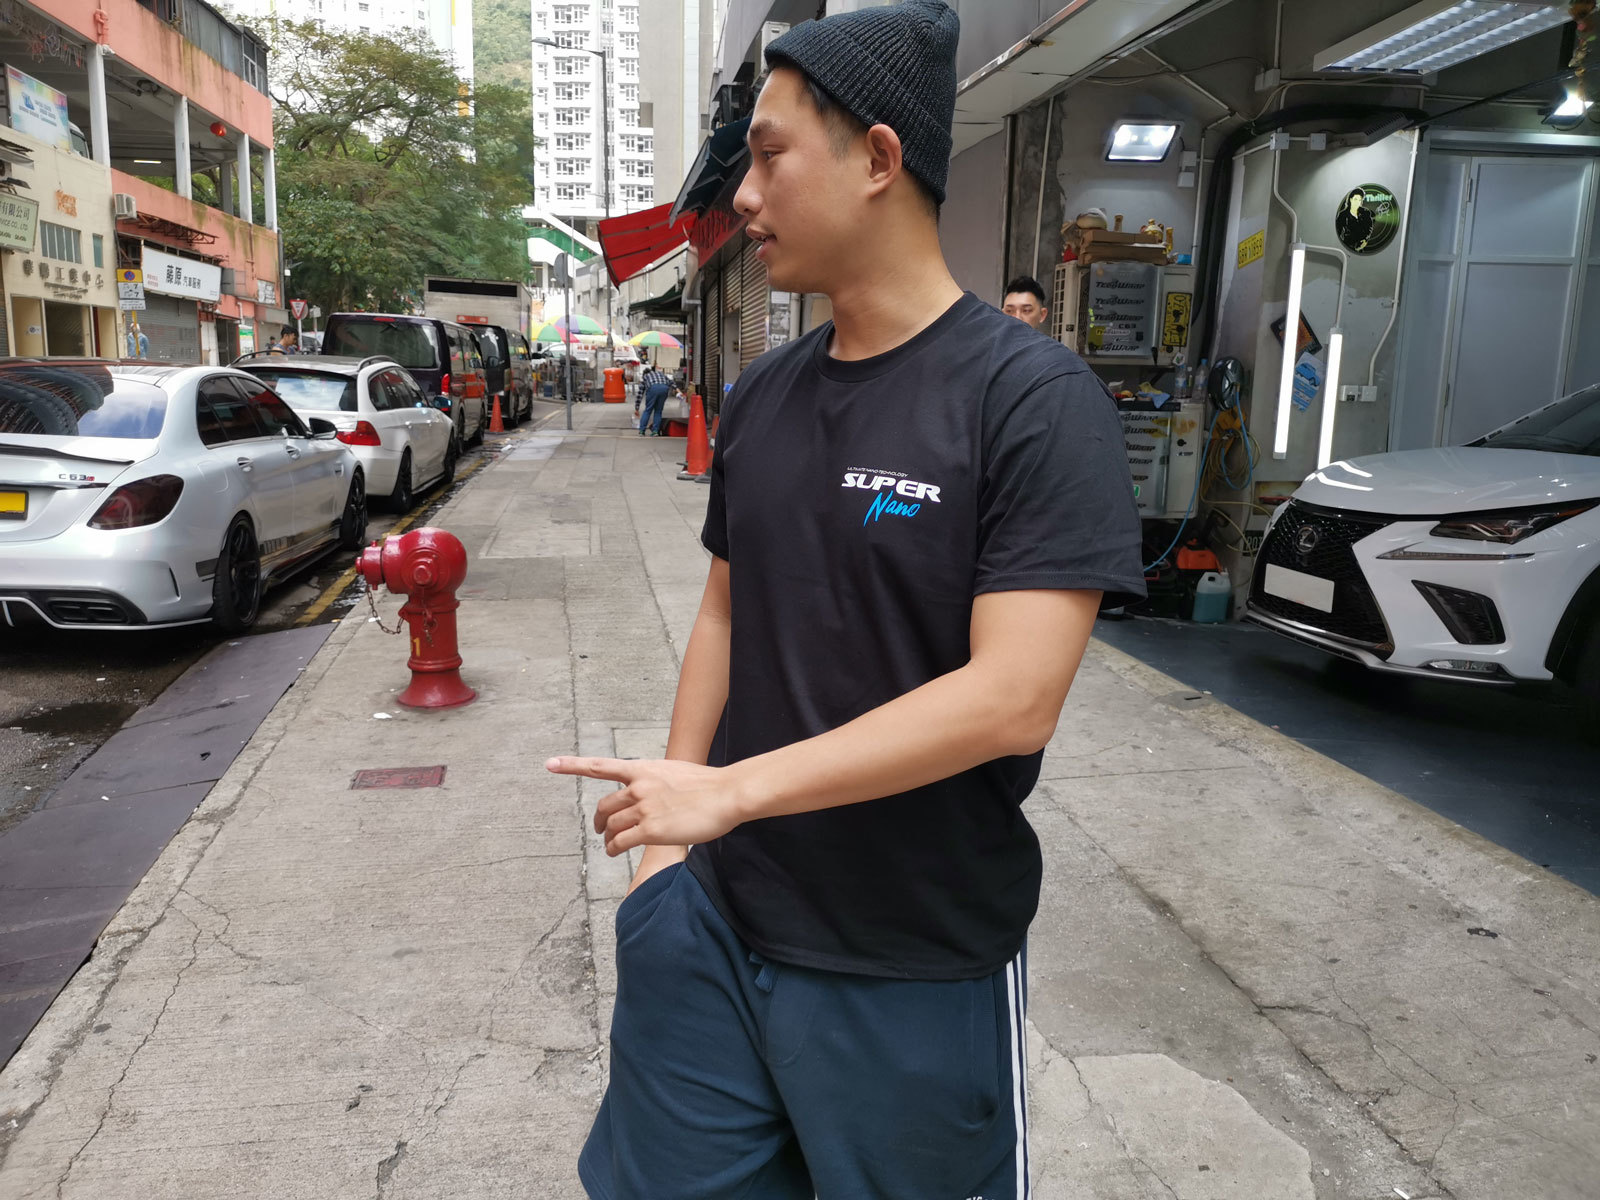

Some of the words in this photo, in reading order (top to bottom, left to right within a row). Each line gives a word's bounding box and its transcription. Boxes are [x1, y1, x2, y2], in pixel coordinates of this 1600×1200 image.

[1366, 193, 1393, 202] Thriller
[841, 472, 941, 503] SUPER
[863, 490, 921, 528] Nano
